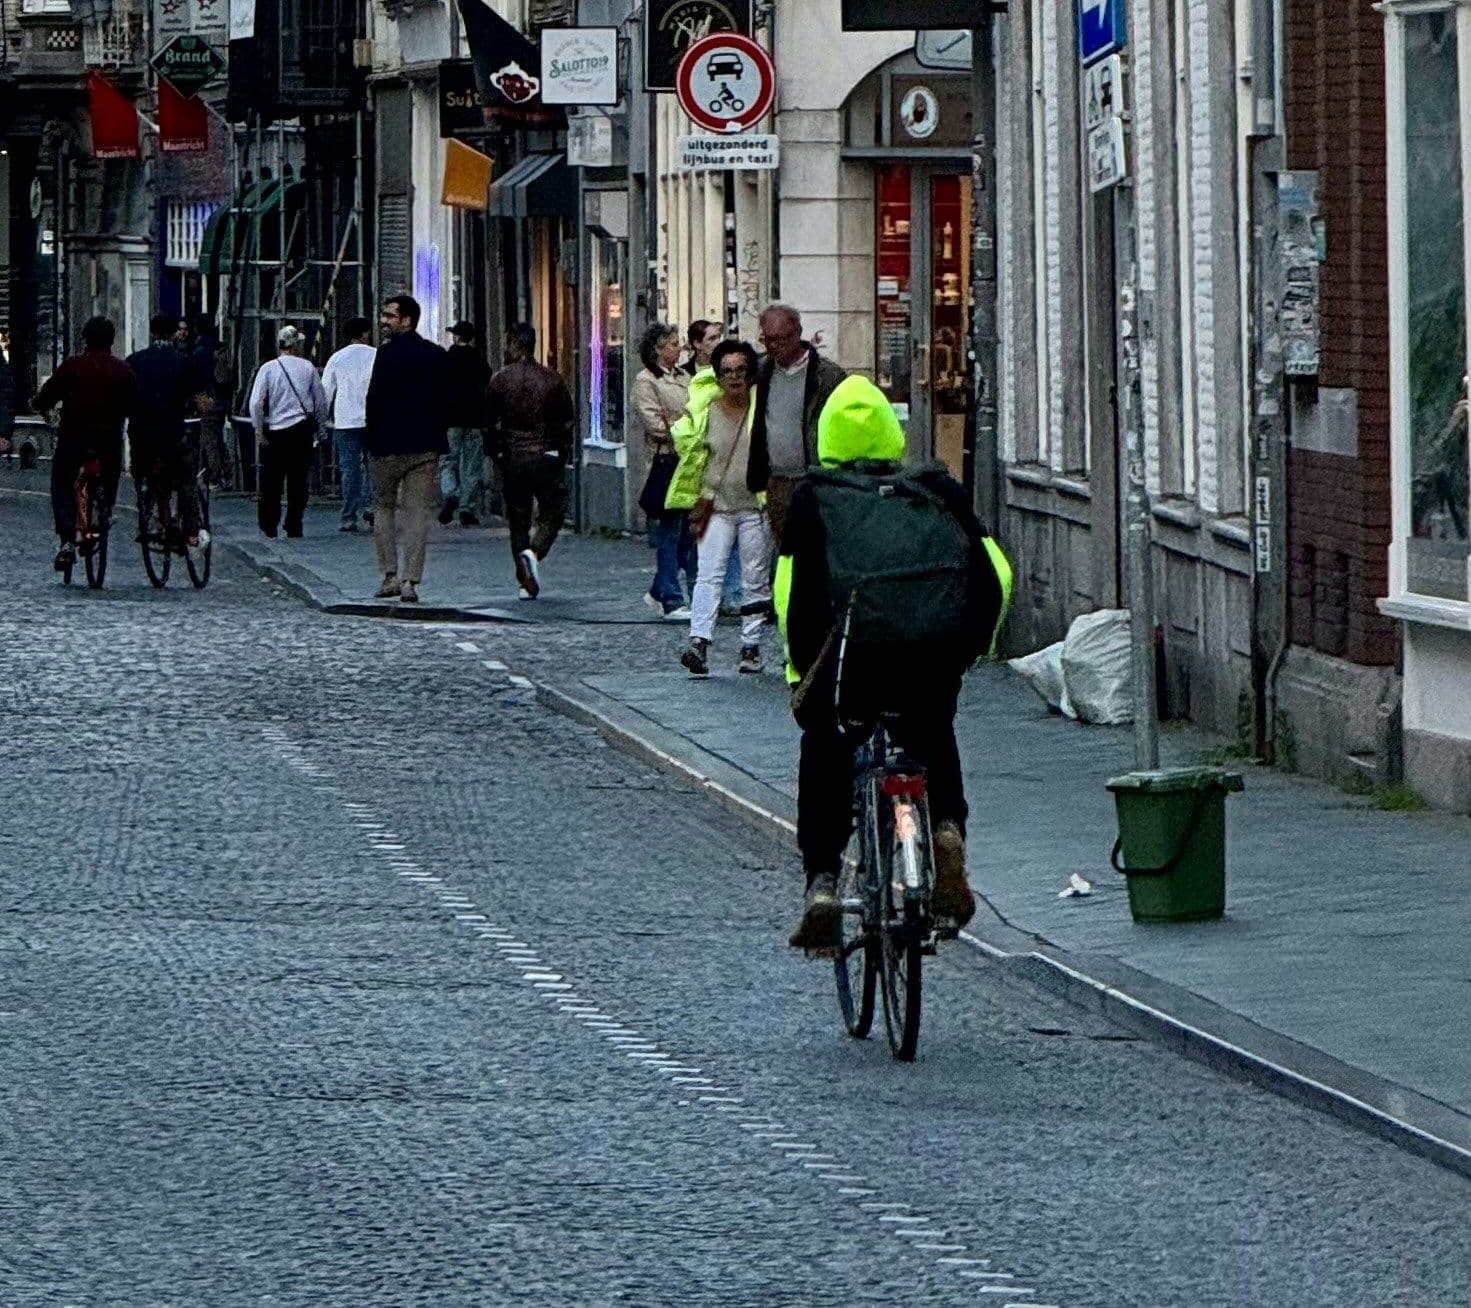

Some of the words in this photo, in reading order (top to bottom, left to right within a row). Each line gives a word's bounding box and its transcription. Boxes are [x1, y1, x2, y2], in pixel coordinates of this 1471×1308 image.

[165, 50, 212, 64] Brand
[163, 140, 205, 151] Maastricht
[687, 139, 768, 152] uitgezonderd
[96, 148, 136, 158] Maastricht
[683, 154, 725, 167] lijnbus
[729, 156, 744, 164] en
[748, 153, 773, 164] taxi
